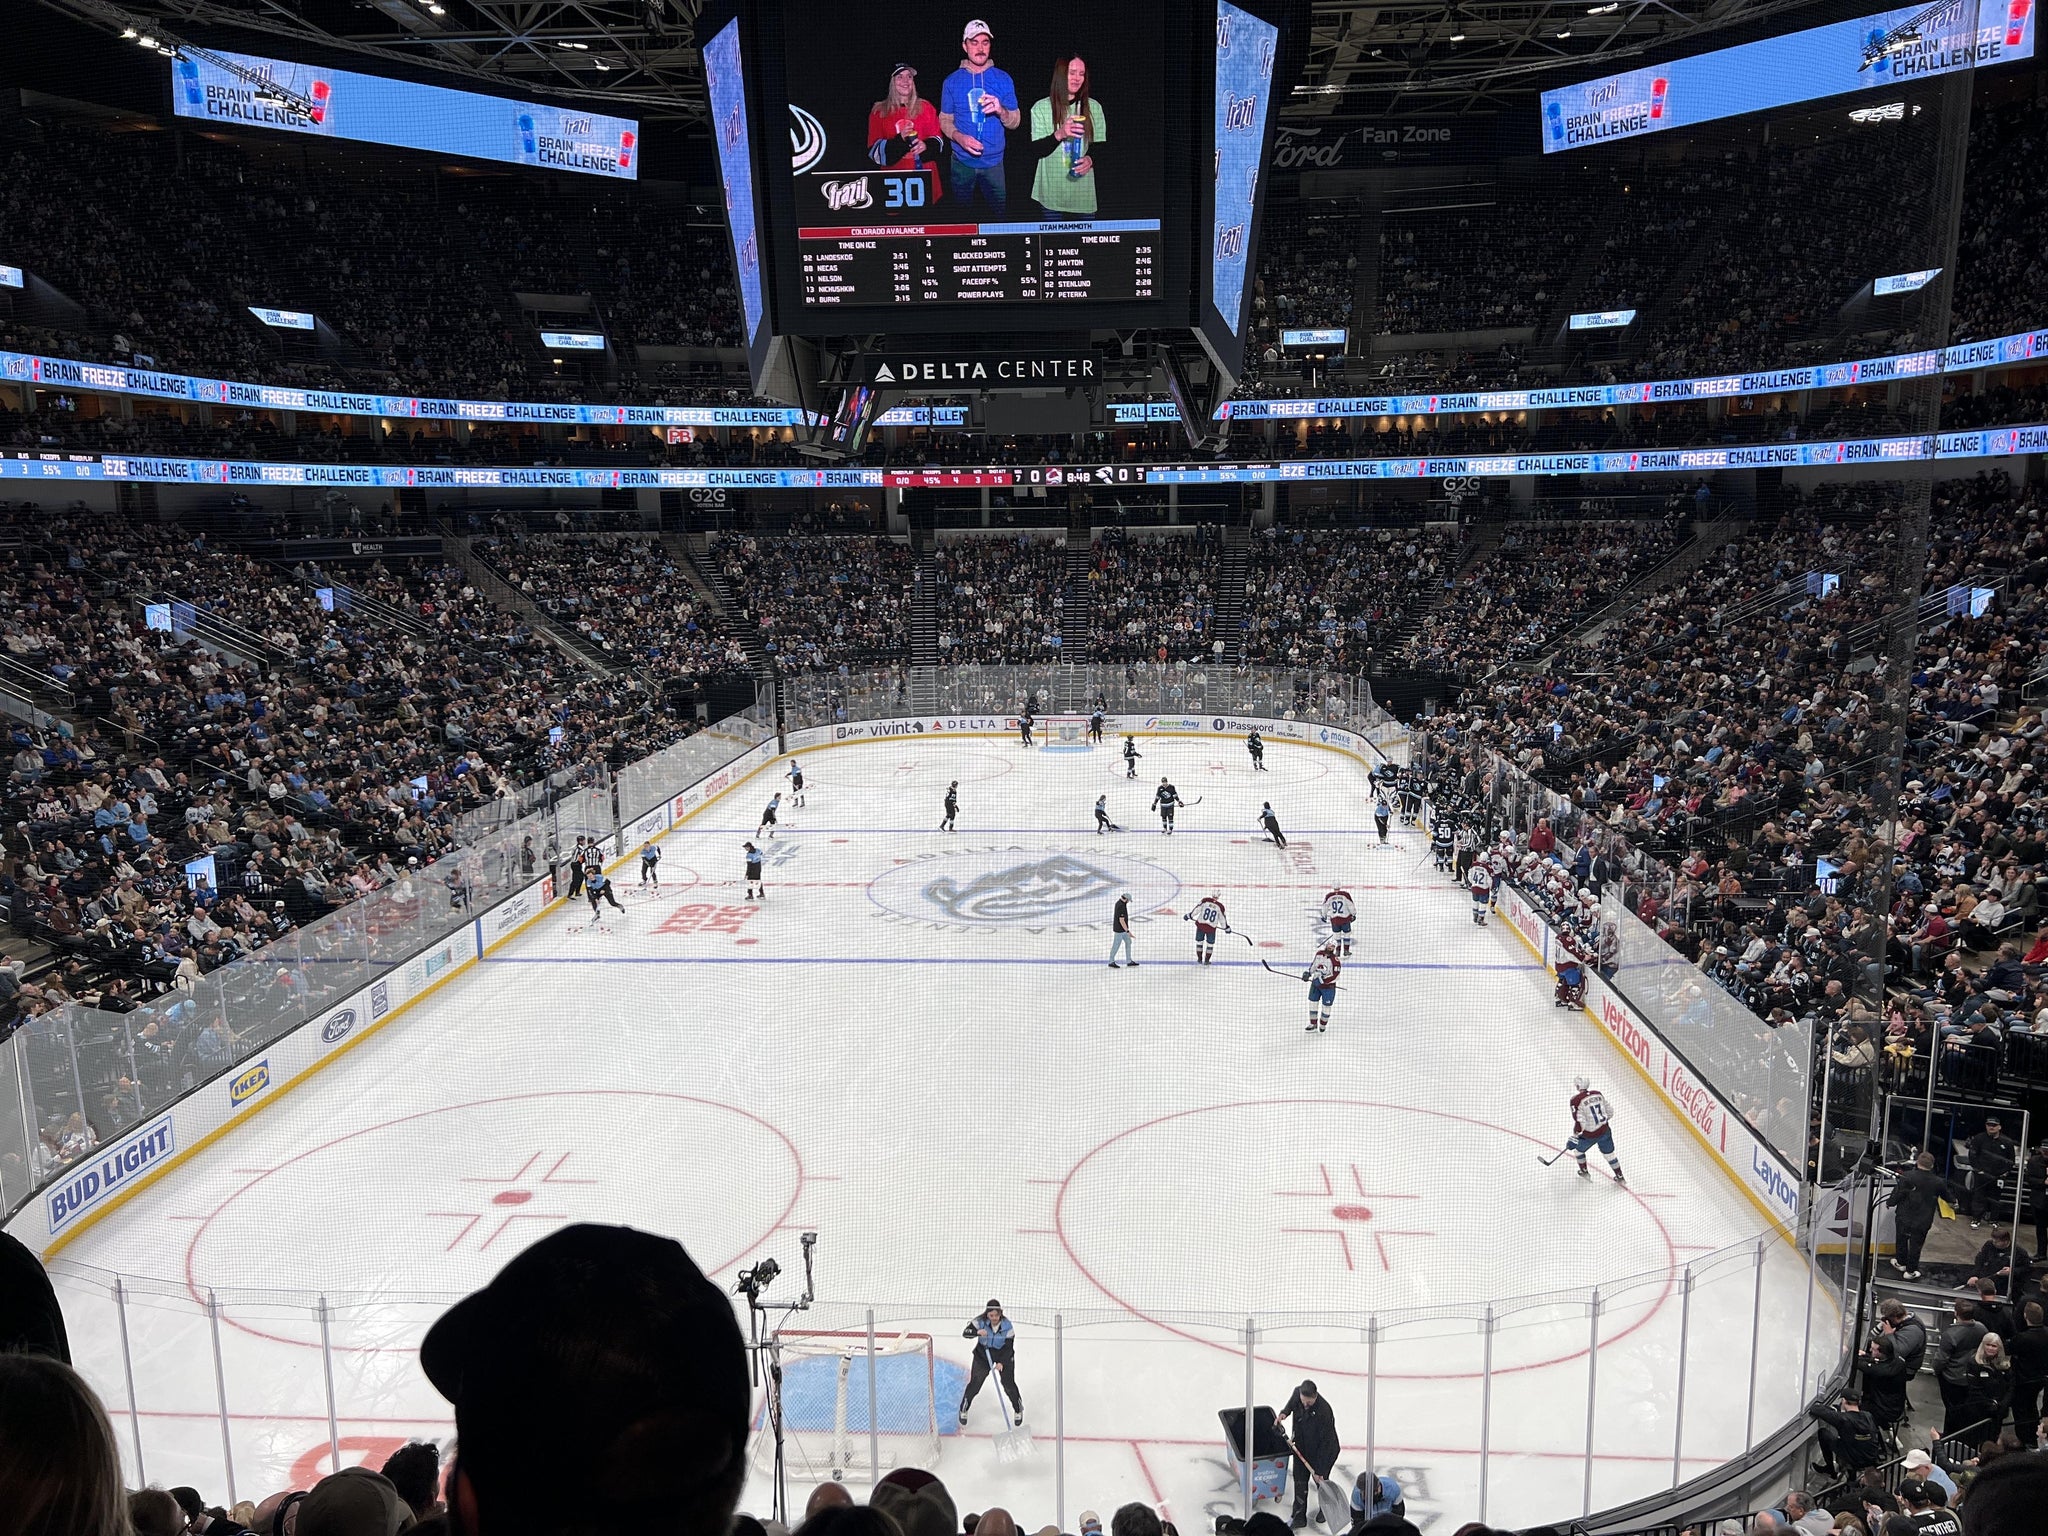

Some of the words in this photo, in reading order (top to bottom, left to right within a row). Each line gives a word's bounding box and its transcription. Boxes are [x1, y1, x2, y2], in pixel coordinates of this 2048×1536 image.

[1893, 41, 2001, 77] CHALLENGE
[207, 85, 251, 103] BRAIN
[1591, 79, 1618, 107] frazil
[207, 99, 308, 128] CHALLENGE
[1225, 93, 1256, 132] frazil
[1567, 113, 1601, 129] BRAIN
[1603, 101, 1648, 123] FREEZE
[563, 115, 592, 137] frazil
[1567, 114, 1648, 144] CHALLENGE
[539, 136, 573, 152] BRAIN
[575, 142, 617, 159] FREEZE
[1273, 127, 1350, 167] Ford
[1363, 127, 1398, 143] Fan
[1403, 126, 1450, 142] Zone
[539, 149, 617, 173] CHALLENGE
[826, 177, 868, 210] frazil
[884, 177, 925, 208] 30
[886, 227, 925, 235] AVALANCHE
[1058, 223, 1092, 231] MAMMOTH
[1025, 237, 1031, 245] 5
[1216, 223, 1244, 261] frazil
[818, 285, 855, 293] NICHUSHKIN
[5, 357, 26, 376] frazil
[903, 362, 987, 380] DELTA
[998, 359, 1095, 379] CENTER
[1861, 361, 1895, 378] BRAIN
[1937, 344, 1994, 368] CHALLENGE
[44, 362, 81, 382] BRAIN
[82, 366, 126, 388] FREEZE
[127, 372, 186, 395] CHALLENGE
[1654, 383, 1692, 397] BRAIN
[1694, 378, 1740, 395] FREEZE
[1743, 372, 1811, 390] CHALLENGE
[230, 386, 260, 403] BRAIN
[262, 389, 304, 407] FREEZE
[306, 393, 372, 411] CHALLENGE
[1440, 396, 1477, 409] BRAIN
[1479, 395, 1527, 408] FREEZE
[1529, 390, 1601, 405] CHALLENGE
[421, 402, 457, 416] BRAIN
[458, 403, 505, 418] FREEZE
[506, 405, 576, 420] CHALLENGE
[628, 409, 664, 422] BRAIN
[665, 411, 712, 423] FREEZE
[713, 411, 784, 424] CHALLENGE
[1233, 404, 1268, 416] BRAIN
[1269, 402, 1316, 415] FREEZE
[1317, 400, 1387, 413] CHALLENGE
[669, 430, 691, 444] PB
[1847, 443, 1880, 459] BRAIN
[1923, 436, 1979, 455] CHALLENGE
[1429, 460, 1466, 473] BRAIN
[1468, 459, 1515, 472] FREEZE
[1518, 457, 1589, 471] CHALLENGE
[1641, 455, 1679, 468] BRAIN
[1681, 453, 1726, 466] FREEZE
[1729, 448, 1797, 465] CHALLENGE
[22, 464, 28, 474] 3
[42, 465, 60, 476] 55%
[76, 466, 90, 476] 0/0
[128, 460, 188, 479] CHALLENGE
[231, 462, 261, 481] BRAIN
[262, 465, 304, 482] FREEZE
[305, 468, 369, 484] CHALLENGE
[417, 470, 454, 484] BRAIN
[455, 471, 500, 485] FREEZE
[501, 472, 571, 485] CHALLENGE
[1030, 470, 1040, 483] 0
[1067, 472, 1091, 482] 8:48
[1119, 469, 1128, 481] 0
[1220, 472, 1237, 480] 55%
[1252, 471, 1265, 479] 0/0
[1308, 463, 1377, 476] CHALLENGE
[623, 473, 659, 485] BRAIN
[660, 473, 706, 485] FREEZE
[708, 473, 777, 485] CHALLENGE
[826, 473, 861, 485] BRAIN
[1443, 476, 1481, 491] G2G
[689, 488, 726, 503] G2G
[870, 721, 911, 737] vivint
[948, 719, 996, 730] DELTA
[1158, 719, 1200, 729] SameDay
[1438, 827, 1451, 839] 50
[1473, 873, 1485, 885] 42
[1203, 908, 1218, 923] 88
[1331, 901, 1344, 914] 92
[324, 1010, 356, 1041] Ford
[1603, 995, 1651, 1069] verizon
[233, 1068, 267, 1098] IKEA
[1590, 1104, 1606, 1125] 13
[51, 1168, 101, 1224] BUD
[103, 1125, 169, 1188] LIGHT
[1753, 1144, 1799, 1215] Layton
